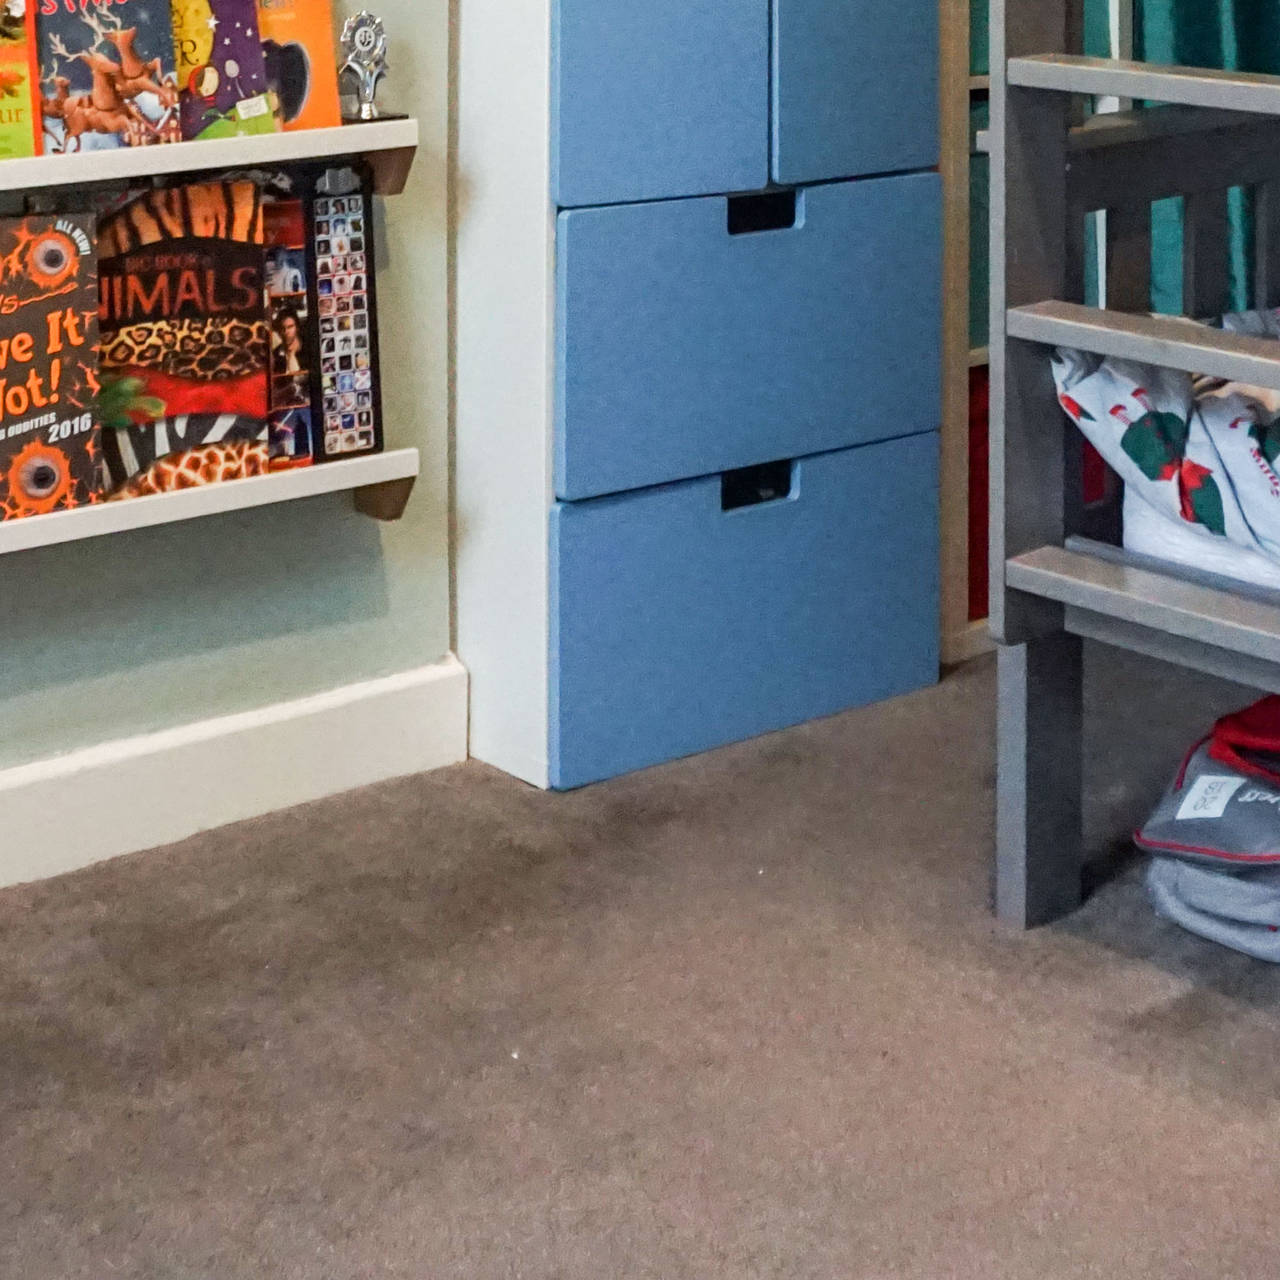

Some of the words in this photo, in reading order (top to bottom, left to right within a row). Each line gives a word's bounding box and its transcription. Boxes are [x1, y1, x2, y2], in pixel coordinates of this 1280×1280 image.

[55, 220, 73, 234] ALL
[71, 227, 92, 256] NEW!
[46, 307, 86, 355] It
[7, 412, 58, 439] ODDITIES
[47, 412, 93, 444] 2016
